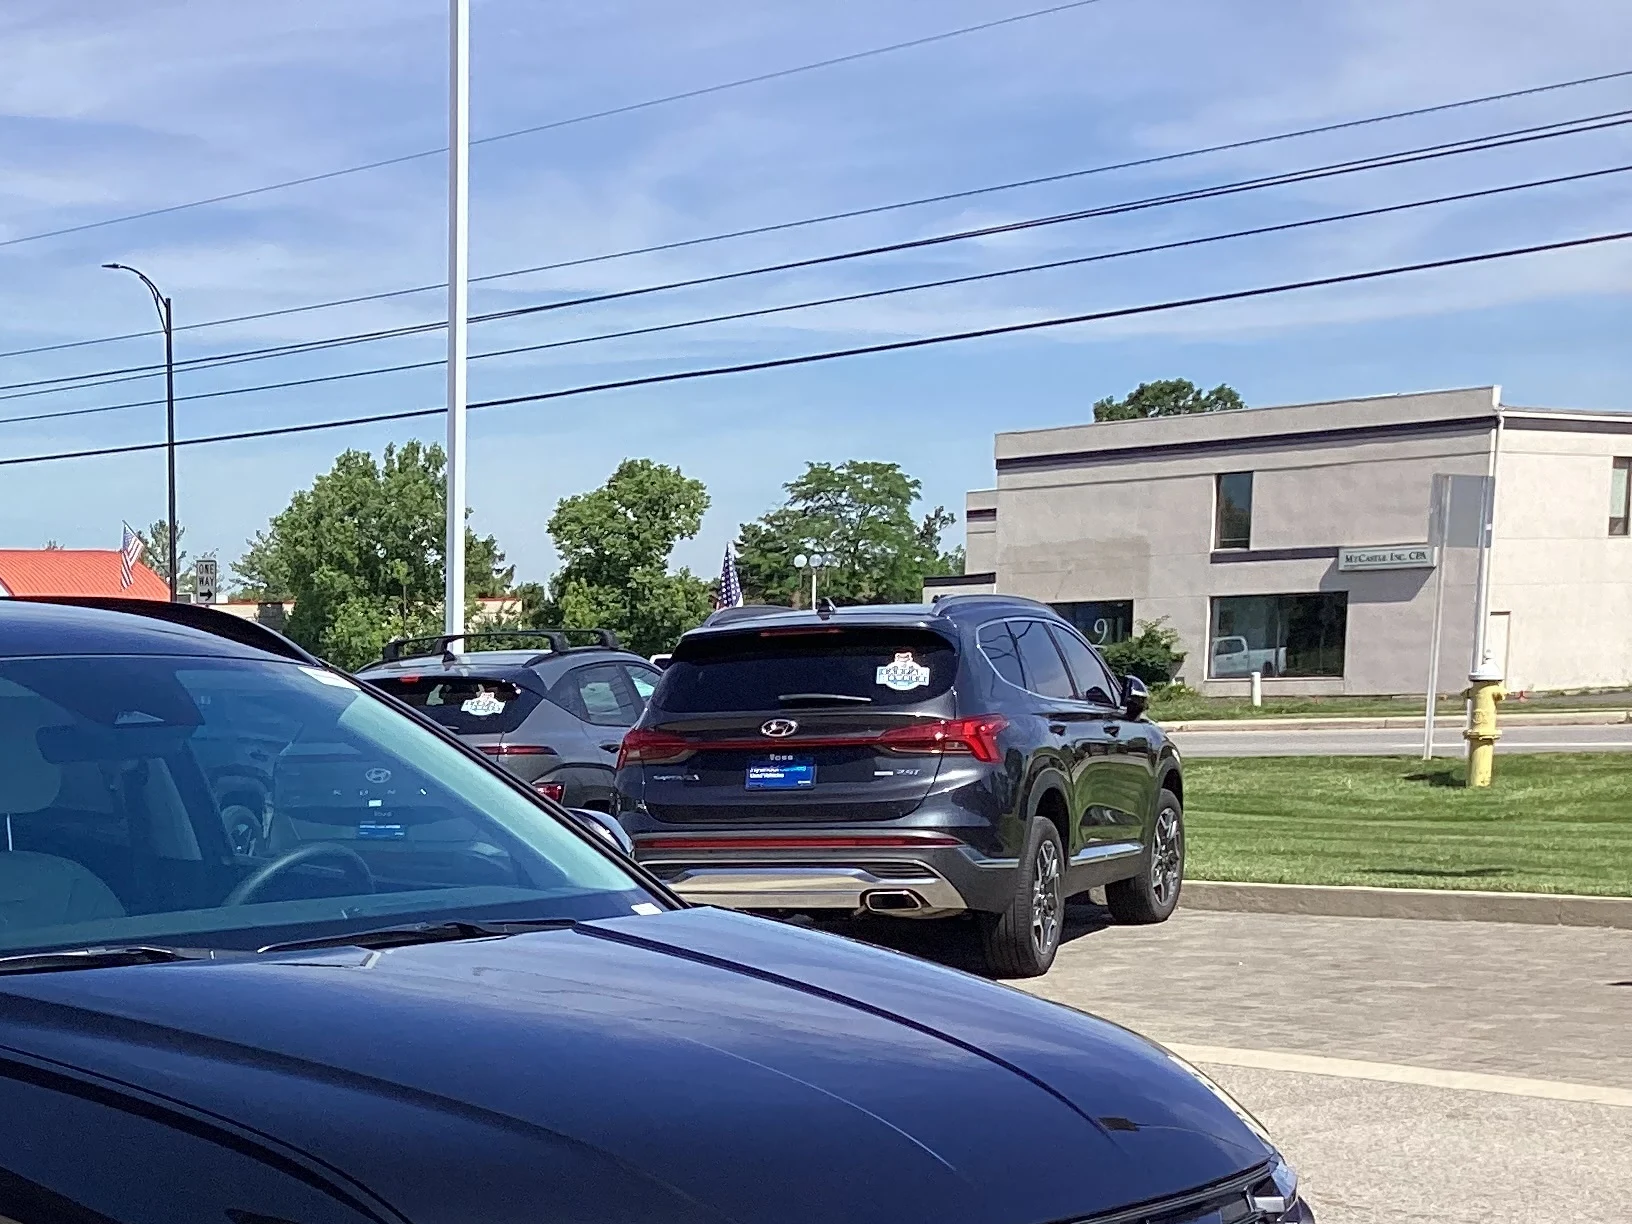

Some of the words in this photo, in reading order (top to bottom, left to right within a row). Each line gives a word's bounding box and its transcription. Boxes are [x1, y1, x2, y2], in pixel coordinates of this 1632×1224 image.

[1409, 551, 1427, 560] CPA
[199, 563, 214, 574] ONE
[199, 576, 214, 586] WAY
